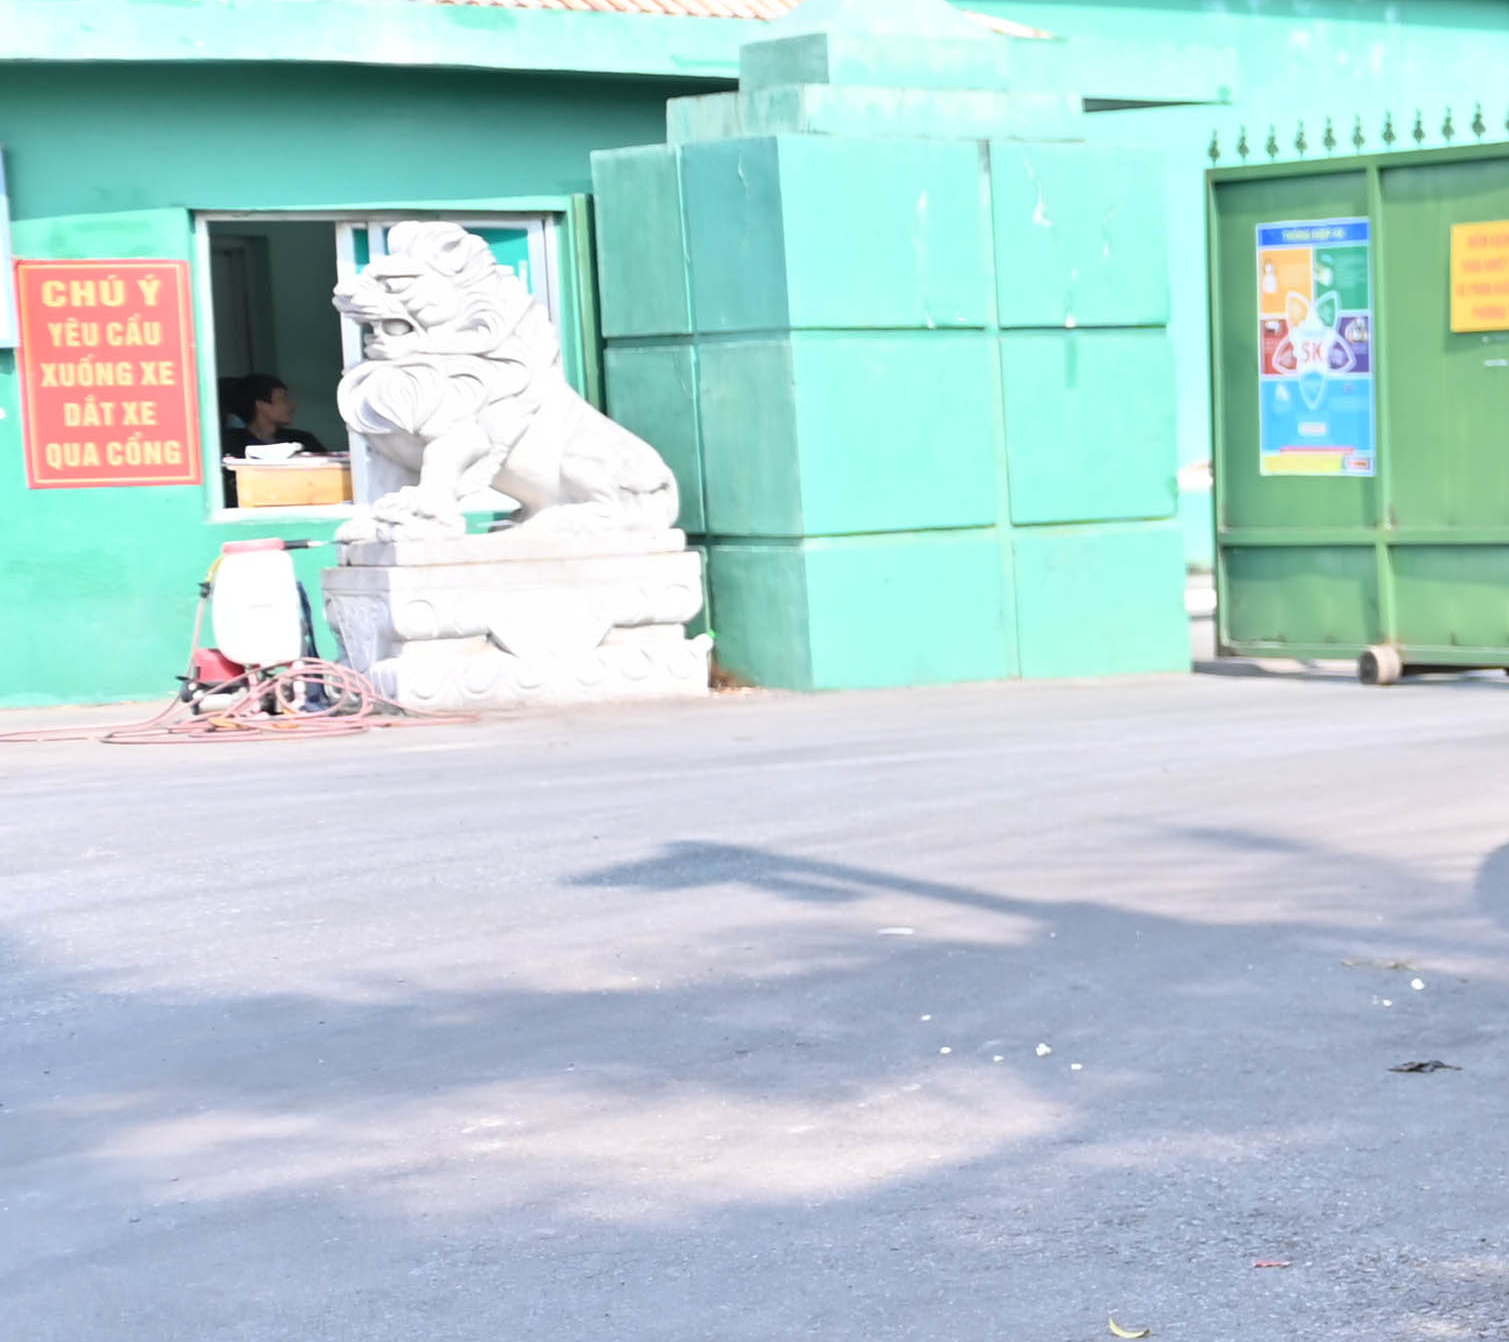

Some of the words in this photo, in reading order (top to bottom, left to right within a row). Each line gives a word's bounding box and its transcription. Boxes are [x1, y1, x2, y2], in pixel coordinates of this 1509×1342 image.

[41, 273, 126, 308] CHÚ
[136, 273, 163, 307] Ý
[48, 316, 99, 347] YÊU
[40, 352, 134, 388] XUỐNG
[140, 360, 176, 386] XE
[122, 400, 157, 427] XE
[45, 441, 101, 470] QUA
